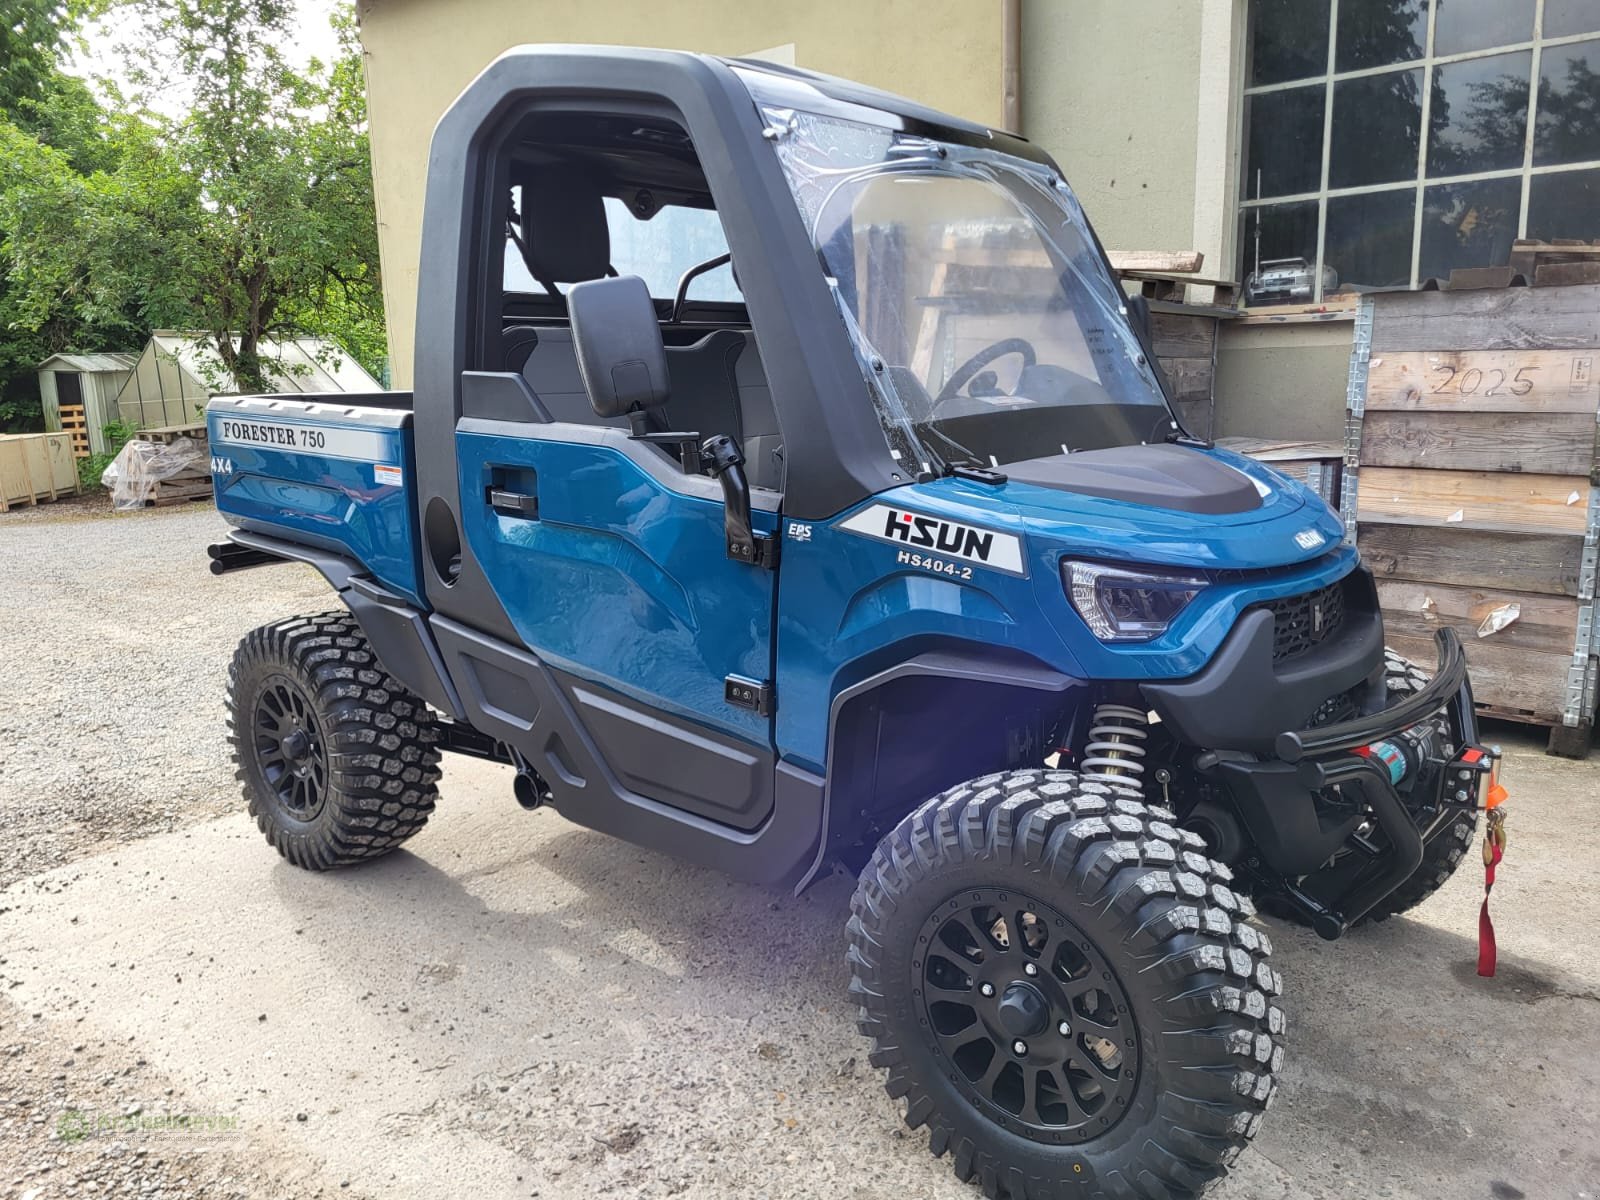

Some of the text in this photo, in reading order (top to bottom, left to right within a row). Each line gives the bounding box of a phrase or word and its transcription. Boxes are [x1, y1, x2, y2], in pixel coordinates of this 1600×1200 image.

[1433, 365, 1542, 397] 2025
[223, 421, 325, 449] FORESTER 750
[210, 456, 233, 474] 4X4
[788, 523, 812, 538] EPS
[897, 550, 973, 580] HS404-2
